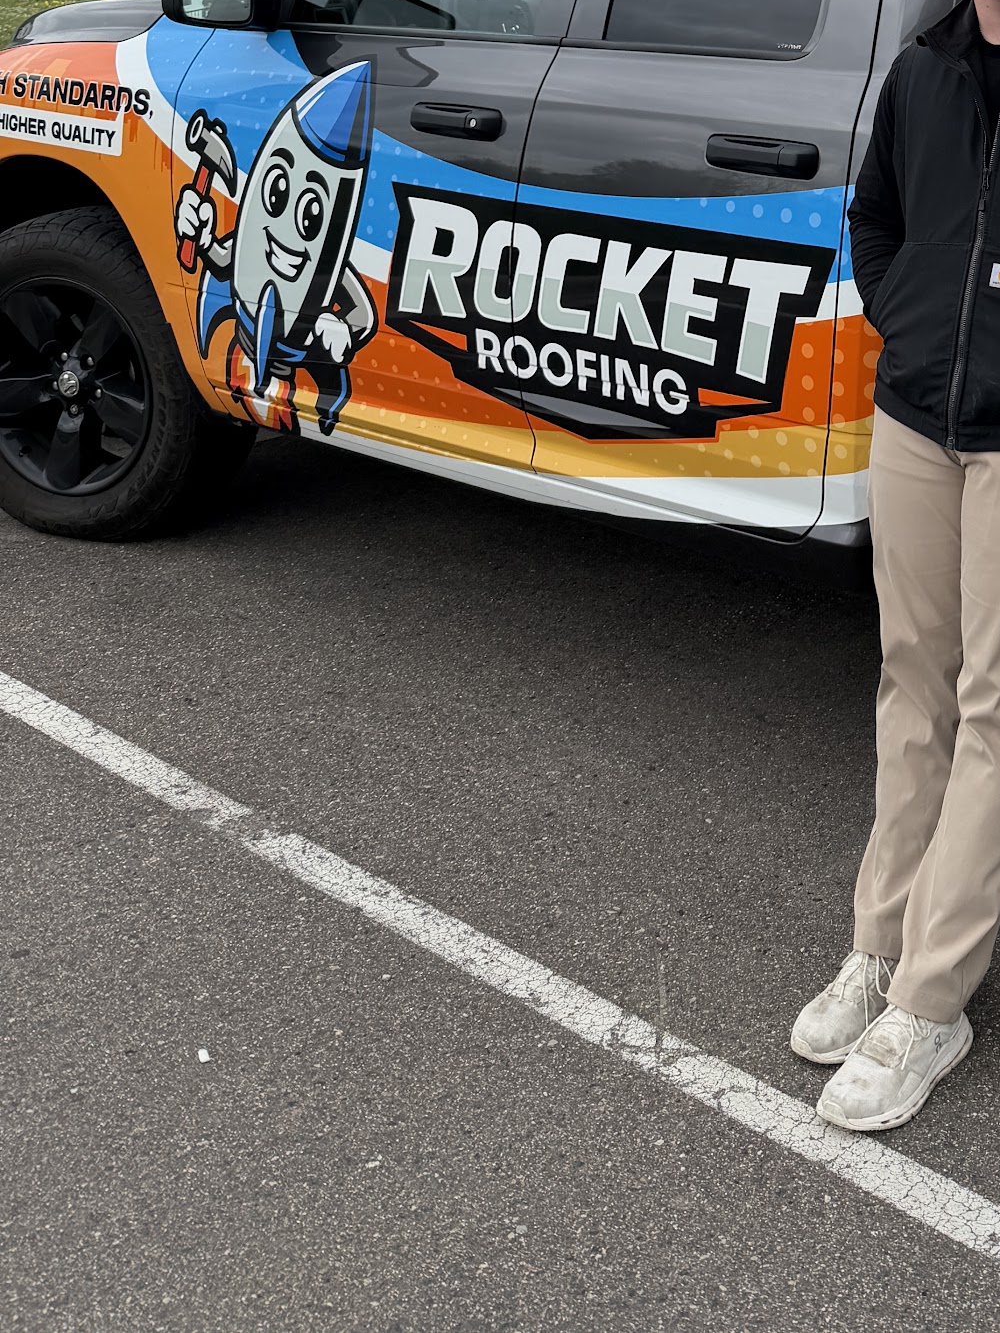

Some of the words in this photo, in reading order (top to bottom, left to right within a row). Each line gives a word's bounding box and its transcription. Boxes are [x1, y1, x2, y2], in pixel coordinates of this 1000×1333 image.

[14, 73, 153, 119] STANDARDS,
[52, 122, 116, 147] QUALITY
[398, 196, 812, 384] ROCKET
[475, 328, 690, 415] ROOFING
